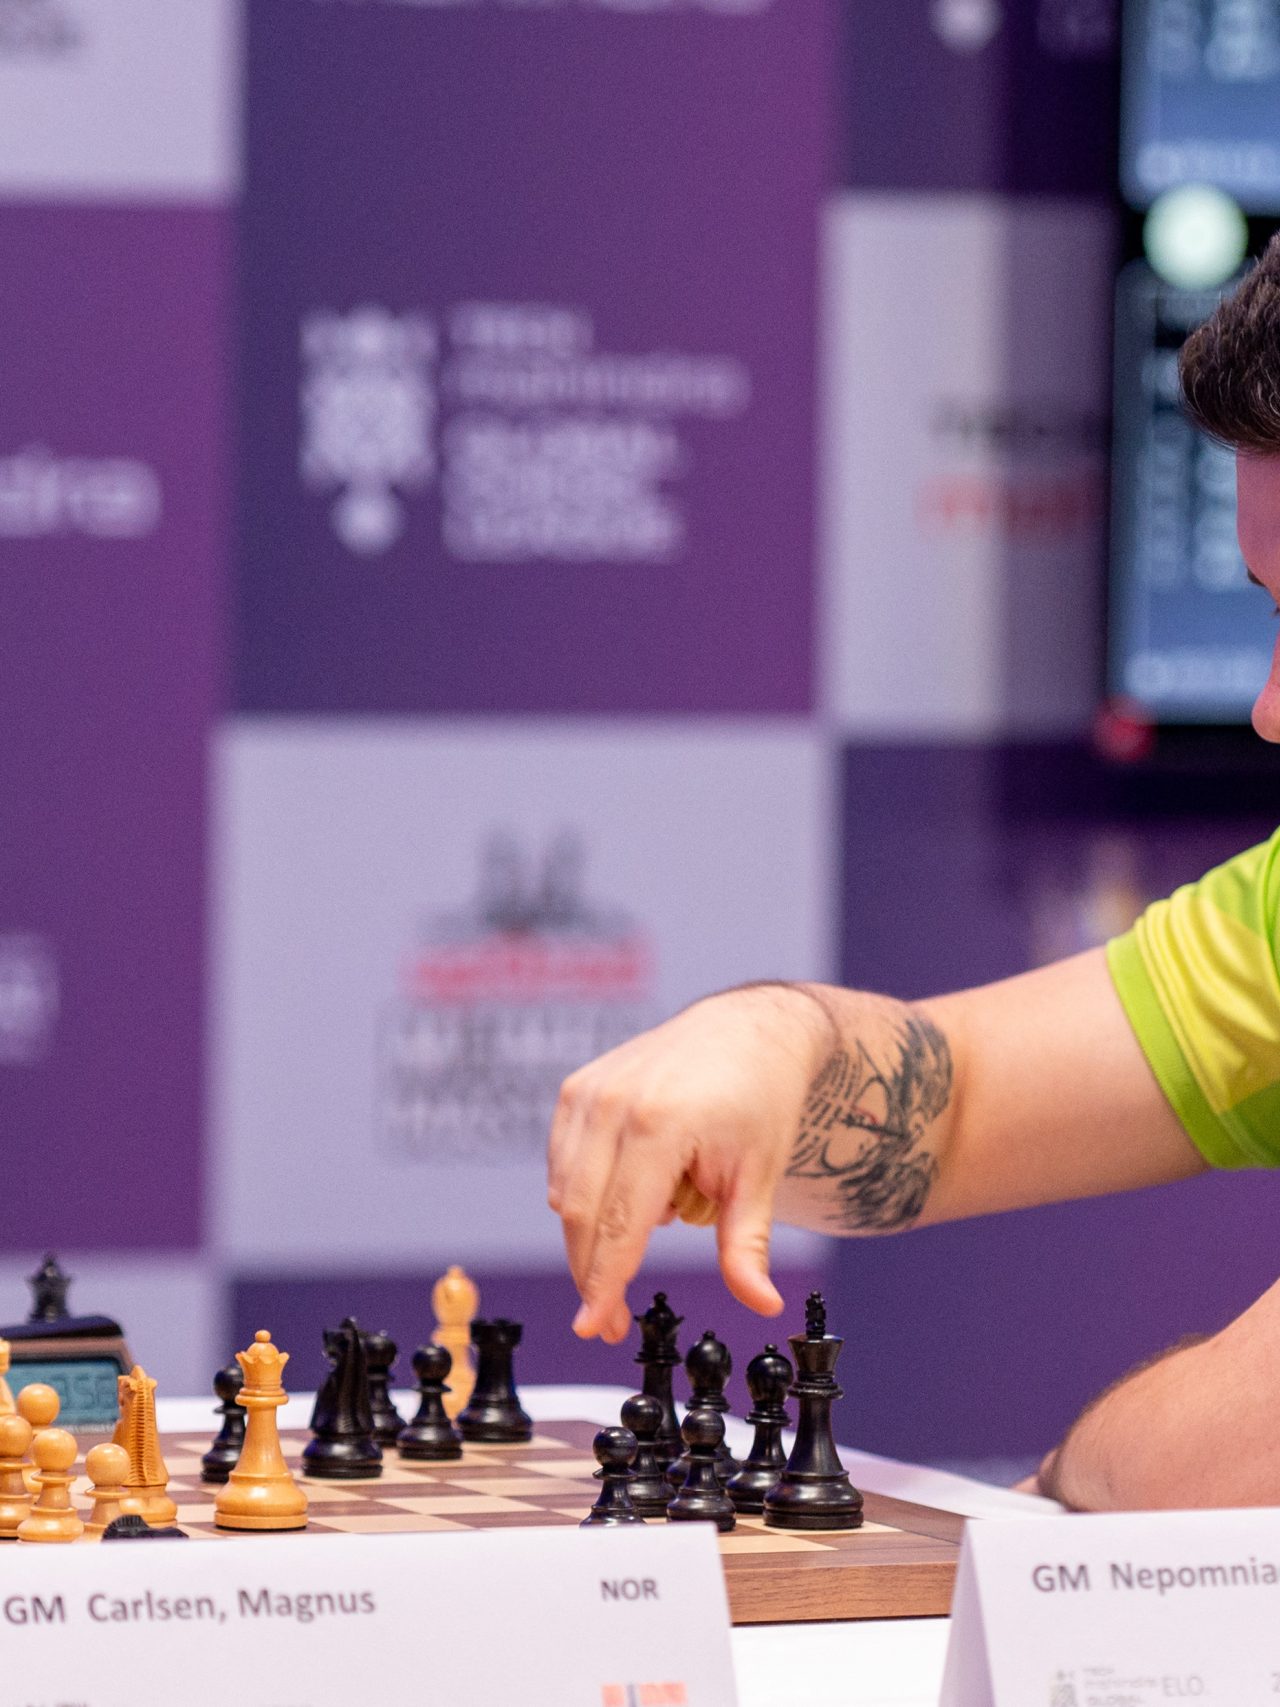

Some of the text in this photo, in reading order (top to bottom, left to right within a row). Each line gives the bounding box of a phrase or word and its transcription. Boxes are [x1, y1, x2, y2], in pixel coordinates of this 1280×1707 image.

[600, 1578, 659, 1601] NOR
[1032, 1564, 1091, 1593] GM
[3, 1588, 376, 1625] GM Carlsen, Magnus
